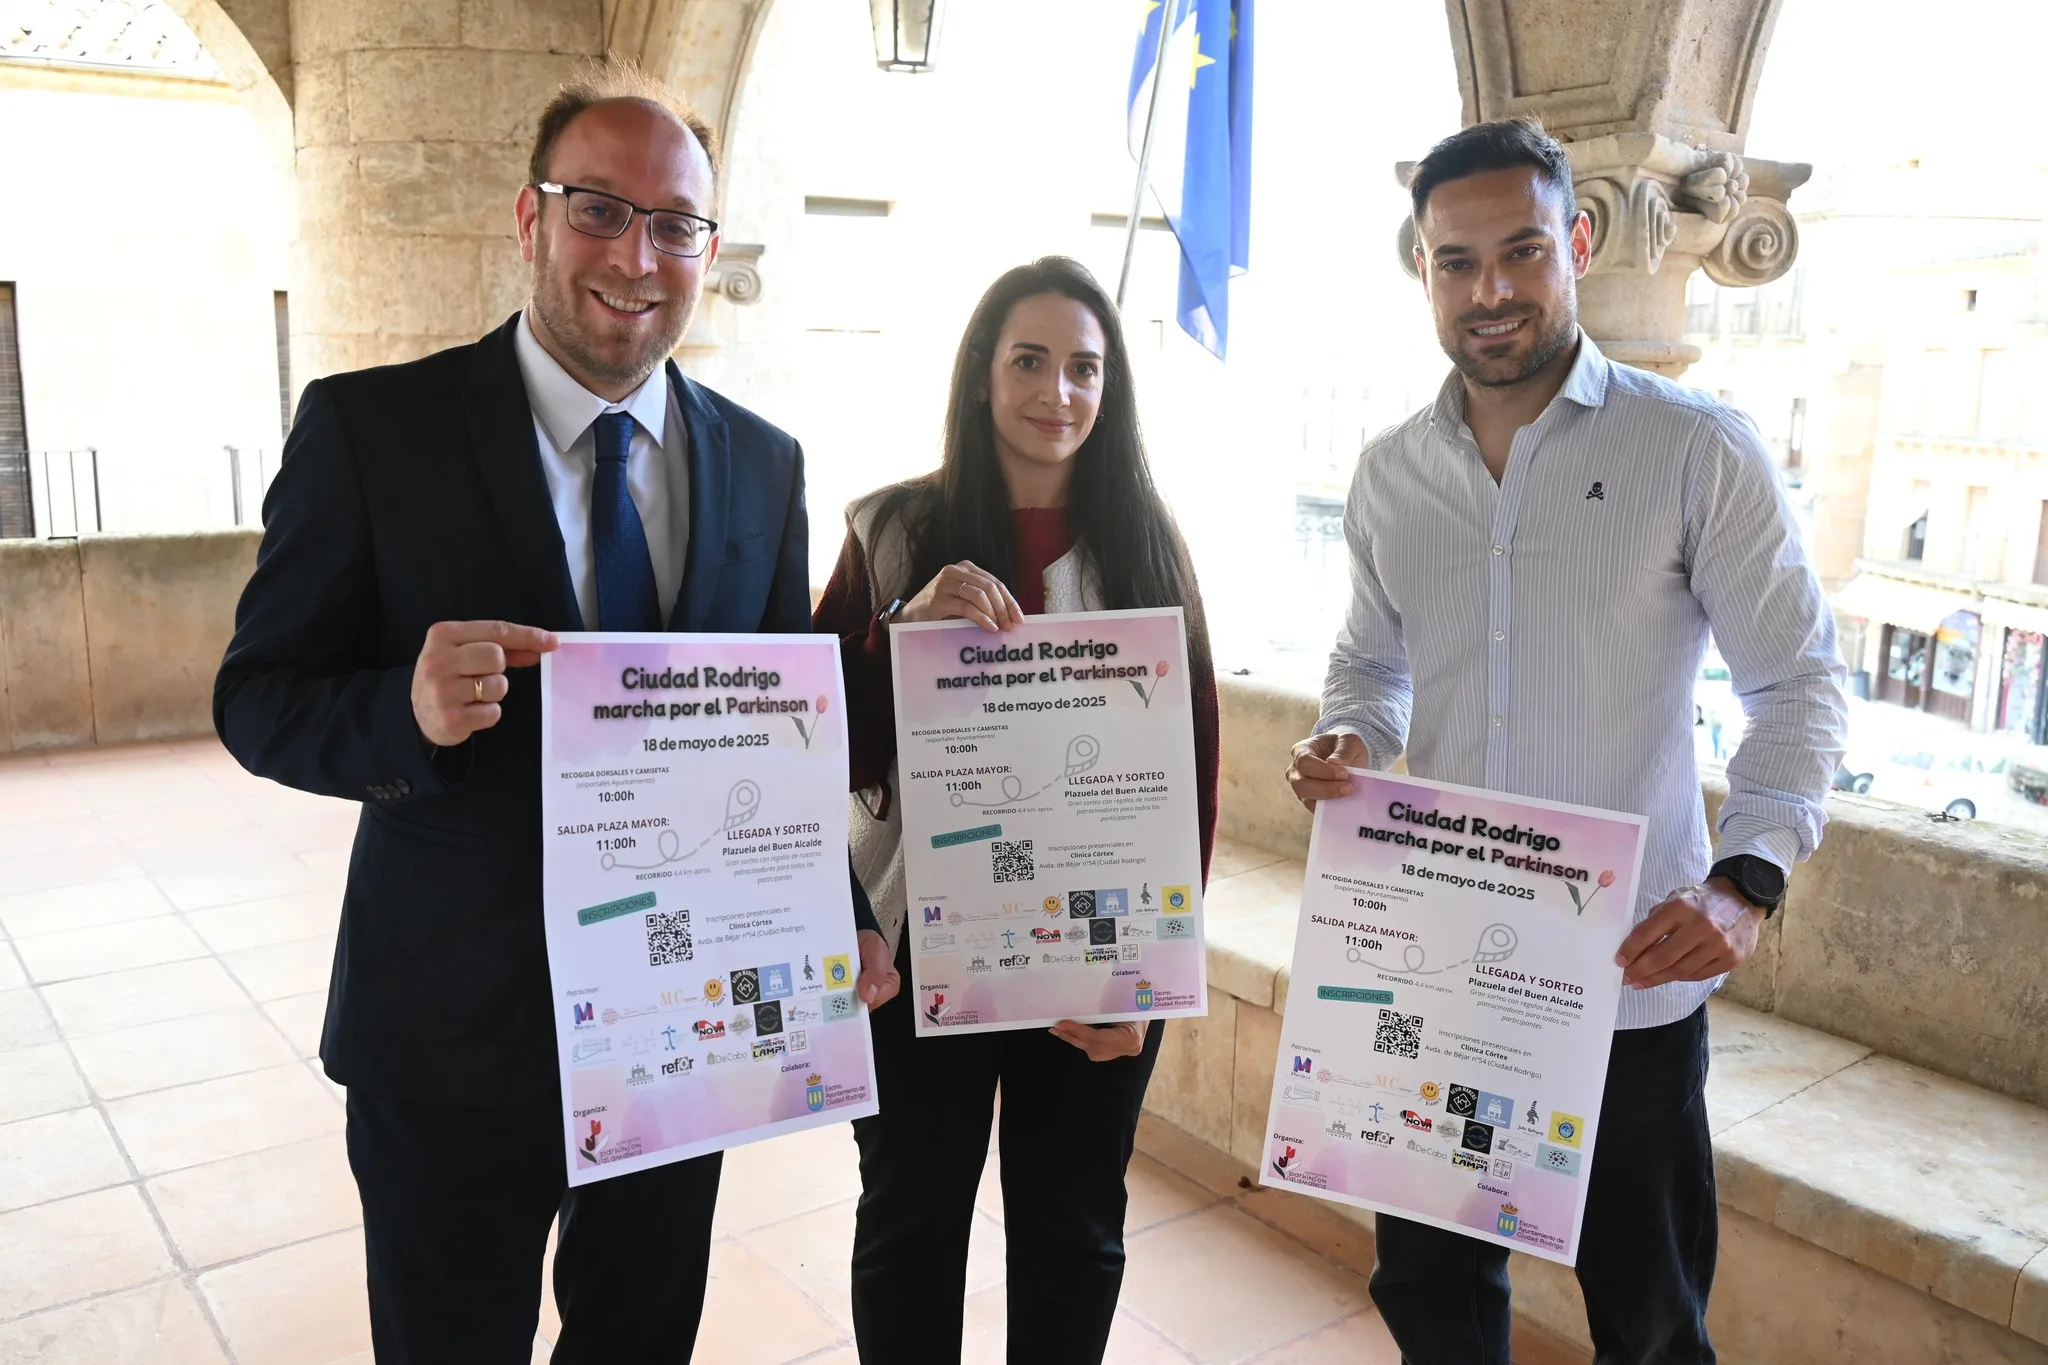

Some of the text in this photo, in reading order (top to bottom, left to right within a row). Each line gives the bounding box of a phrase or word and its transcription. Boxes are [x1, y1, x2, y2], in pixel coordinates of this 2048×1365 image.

[959, 639, 1118, 666] Ciudad Rodrigo
[621, 666, 780, 691] Ciudad Rodrigo
[936, 664, 1147, 690] marcha por el Parkinson
[594, 696, 808, 720] marcha por el Parkinson
[982, 696, 1106, 713] 18 de mayo de 2025
[643, 733, 769, 752] 18 de mayo de 2025
[945, 744, 978, 754] 10:00h
[561, 771, 595, 779] RECOGIDA
[596, 769, 628, 777] DORSALES
[635, 767, 669, 775] CAMISETAS
[910, 765, 1012, 779] SALIDA PLAZA MAYOR:
[1068, 771, 1165, 785] LLEGADA Y SORTEO
[945, 780, 981, 792] 11:00h
[1065, 789, 1099, 798] Plazuela
[1100, 788, 1113, 796] del
[1138, 785, 1168, 793] Alcalde
[598, 790, 634, 803] 10:00h
[557, 817, 670, 836] SALIDA PLAZA MAYOR:
[727, 822, 820, 840] LLEGADA Y SORTEO
[1388, 801, 1561, 852] Ciudad Rodrigo
[597, 836, 636, 851] 11:00h
[934, 826, 999, 846] INSCRIPCIONES
[722, 838, 822, 856] Plazuela del Buen Alcalde
[1087, 842, 1125, 850] presenciales
[1358, 826, 1588, 882] marcha por el Parkinson
[1065, 861, 1081, 869] Béjar
[1097, 858, 1120, 866] (Ciudad
[635, 871, 672, 881] RECORRIDO
[1401, 864, 1535, 900] 18 de mayo de 2025
[1321, 873, 1352, 883] RECOGIDA
[1353, 879, 1384, 889] DORSALES
[1390, 886, 1424, 897] CAMISETAS
[581, 895, 653, 922] INSCRIPCIONES
[1353, 898, 1387, 911] 10:00h
[729, 922, 751, 930] Clínica
[1311, 914, 1418, 942] SALIDA PLAZA MAYOR:
[1345, 935, 1382, 951] 11:00h
[1085, 953, 1118, 962] LAMPI
[1377, 973, 1414, 986] RECORRIDO
[1476, 964, 1583, 995] LLEGADA Y SORTEO
[1320, 988, 1391, 1002] INSCRIPCIONES
[1468, 977, 1584, 1010] Plazuela del Buen Alcalde
[1438, 1029, 1481, 1046] Inscripciones
[1481, 1040, 1522, 1055] presenciales
[1460, 1044, 1508, 1061] Clínica Córtex
[781, 1062, 810, 1073] Colabora:
[1453, 1051, 1471, 1060] Béjar
[1487, 1060, 1513, 1072] (Ciudad
[1513, 1066, 1542, 1080] Rodrigo)
[573, 1106, 607, 1118] Organiza:
[1405, 1118, 1432, 1128] NOVA
[1273, 1133, 1304, 1144] Organiza:
[1361, 1130, 1395, 1145] refor
[1452, 1157, 1488, 1172] LAMPI
[1477, 1183, 1509, 1197] Colabora:
[1517, 1232, 1564, 1251] Ciudad Rodrigo
